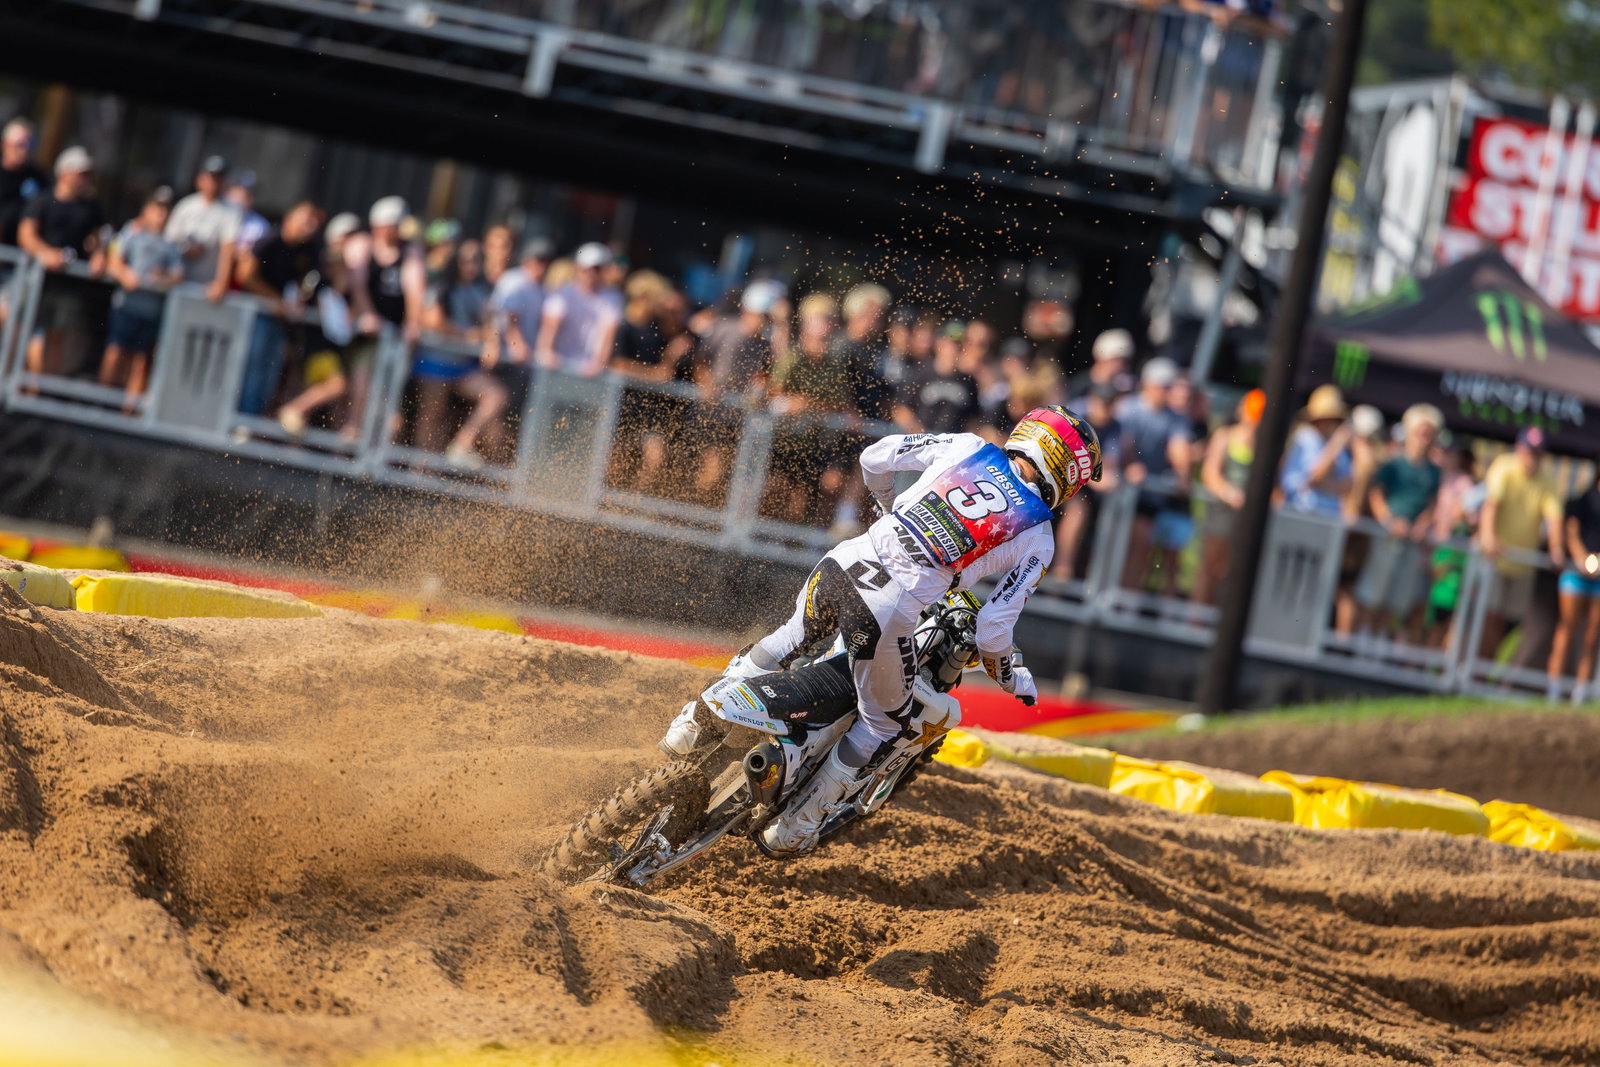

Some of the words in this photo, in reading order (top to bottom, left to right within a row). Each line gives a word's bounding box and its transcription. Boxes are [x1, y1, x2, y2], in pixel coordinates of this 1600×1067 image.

[1028, 425, 1058, 455] LANDON
[985, 464, 1026, 506] GIBSON
[1069, 464, 1077, 482] BELL
[945, 480, 1010, 521] 3
[911, 504, 961, 559] CHAMPIONSHIP
[1003, 563, 1034, 603] Husqvarna
[738, 715, 765, 727] DUNLOP
